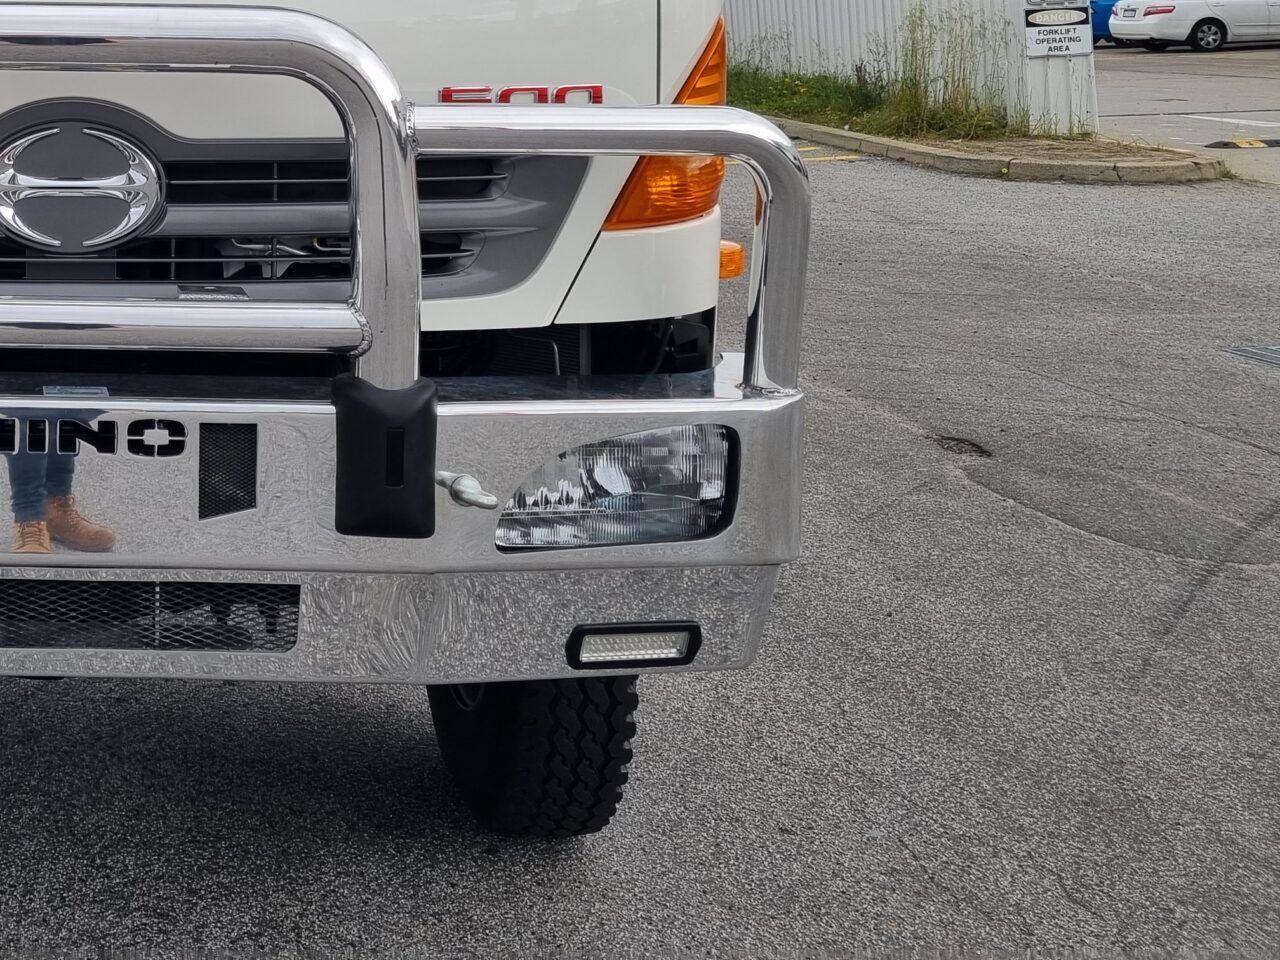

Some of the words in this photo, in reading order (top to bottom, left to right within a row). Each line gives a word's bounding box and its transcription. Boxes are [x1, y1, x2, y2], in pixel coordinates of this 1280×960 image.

[1035, 12, 1079, 22] DANGER
[1037, 28, 1077, 36] FORKLIFT
[1035, 36, 1082, 45] OPERATING
[1047, 45, 1071, 53] AREA
